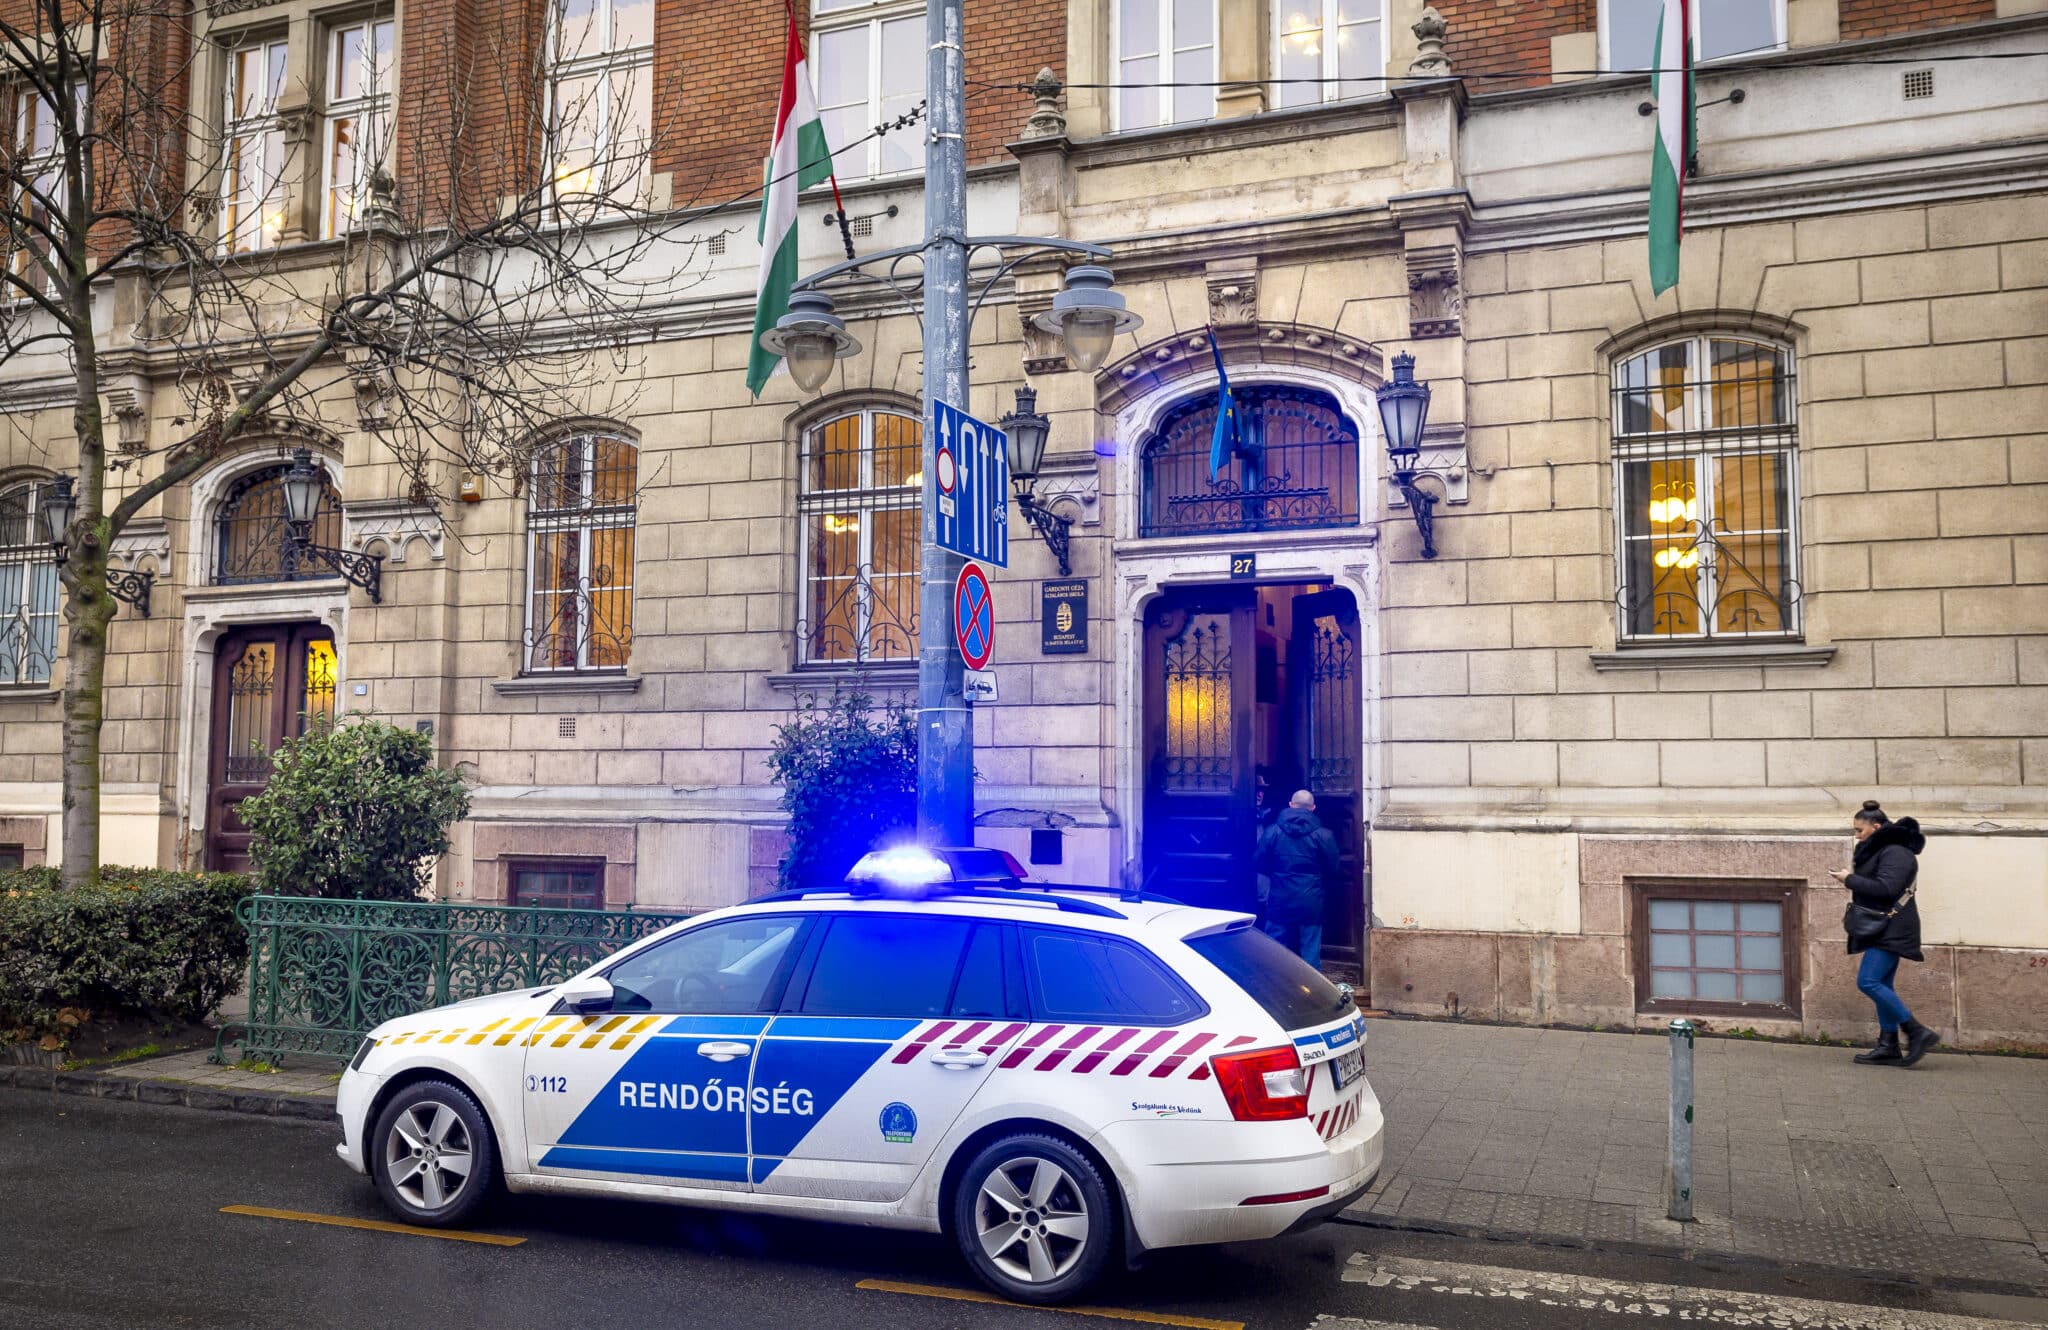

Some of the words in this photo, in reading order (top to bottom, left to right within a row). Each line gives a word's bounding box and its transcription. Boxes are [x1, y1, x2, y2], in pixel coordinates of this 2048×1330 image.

[1233, 559, 1253, 574] 27
[2030, 956, 2048, 968] 29
[540, 1075, 567, 1093] 112
[618, 1078, 815, 1116] RENDŐRSÉG
[1131, 1101, 1167, 1111] Szolgálunk
[1168, 1103, 1176, 1111] és
